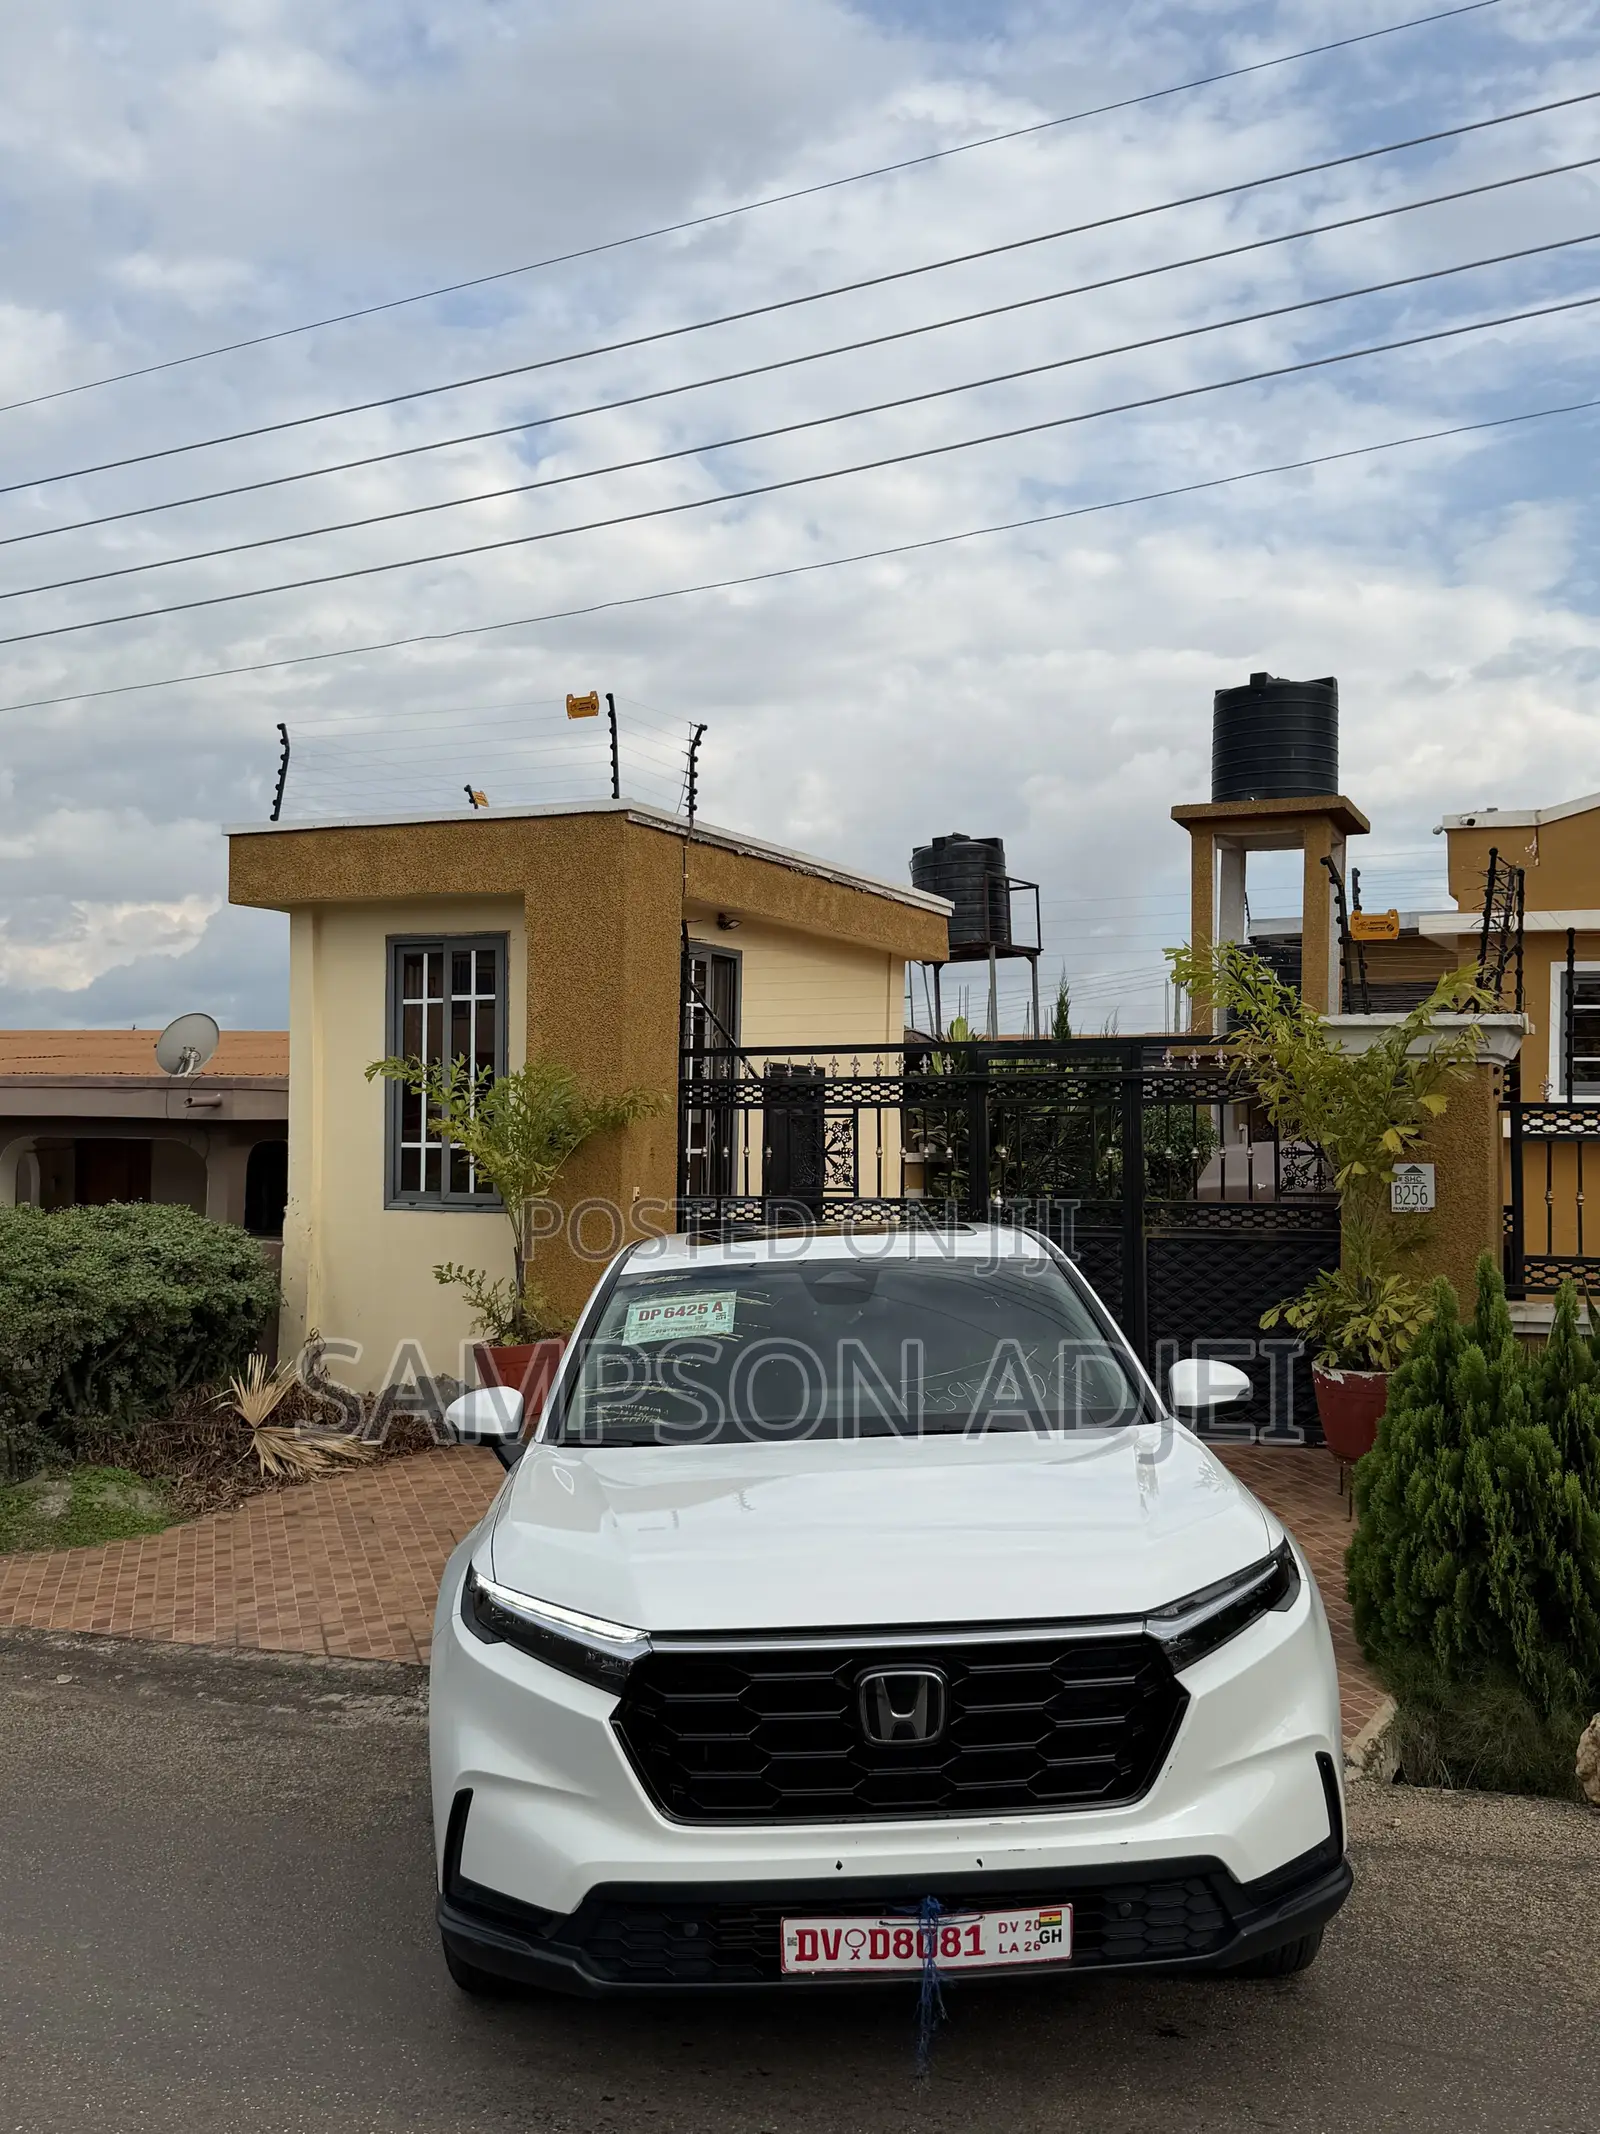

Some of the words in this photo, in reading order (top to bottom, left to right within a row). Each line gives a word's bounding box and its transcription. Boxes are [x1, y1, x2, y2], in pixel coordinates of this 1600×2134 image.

[1394, 1185, 1428, 1206] B256
[638, 1309, 661, 1322] DP
[663, 1303, 709, 1319] 6425
[711, 1300, 723, 1313] A
[999, 1921, 1019, 1935] DV
[1025, 1919, 1041, 1932] 20
[1039, 1928, 1062, 1945] GH
[795, 1928, 843, 1962] DV
[868, 1924, 986, 1960] D8081
[999, 1942, 1019, 1955] LA
[1024, 1940, 1041, 1952] 26
